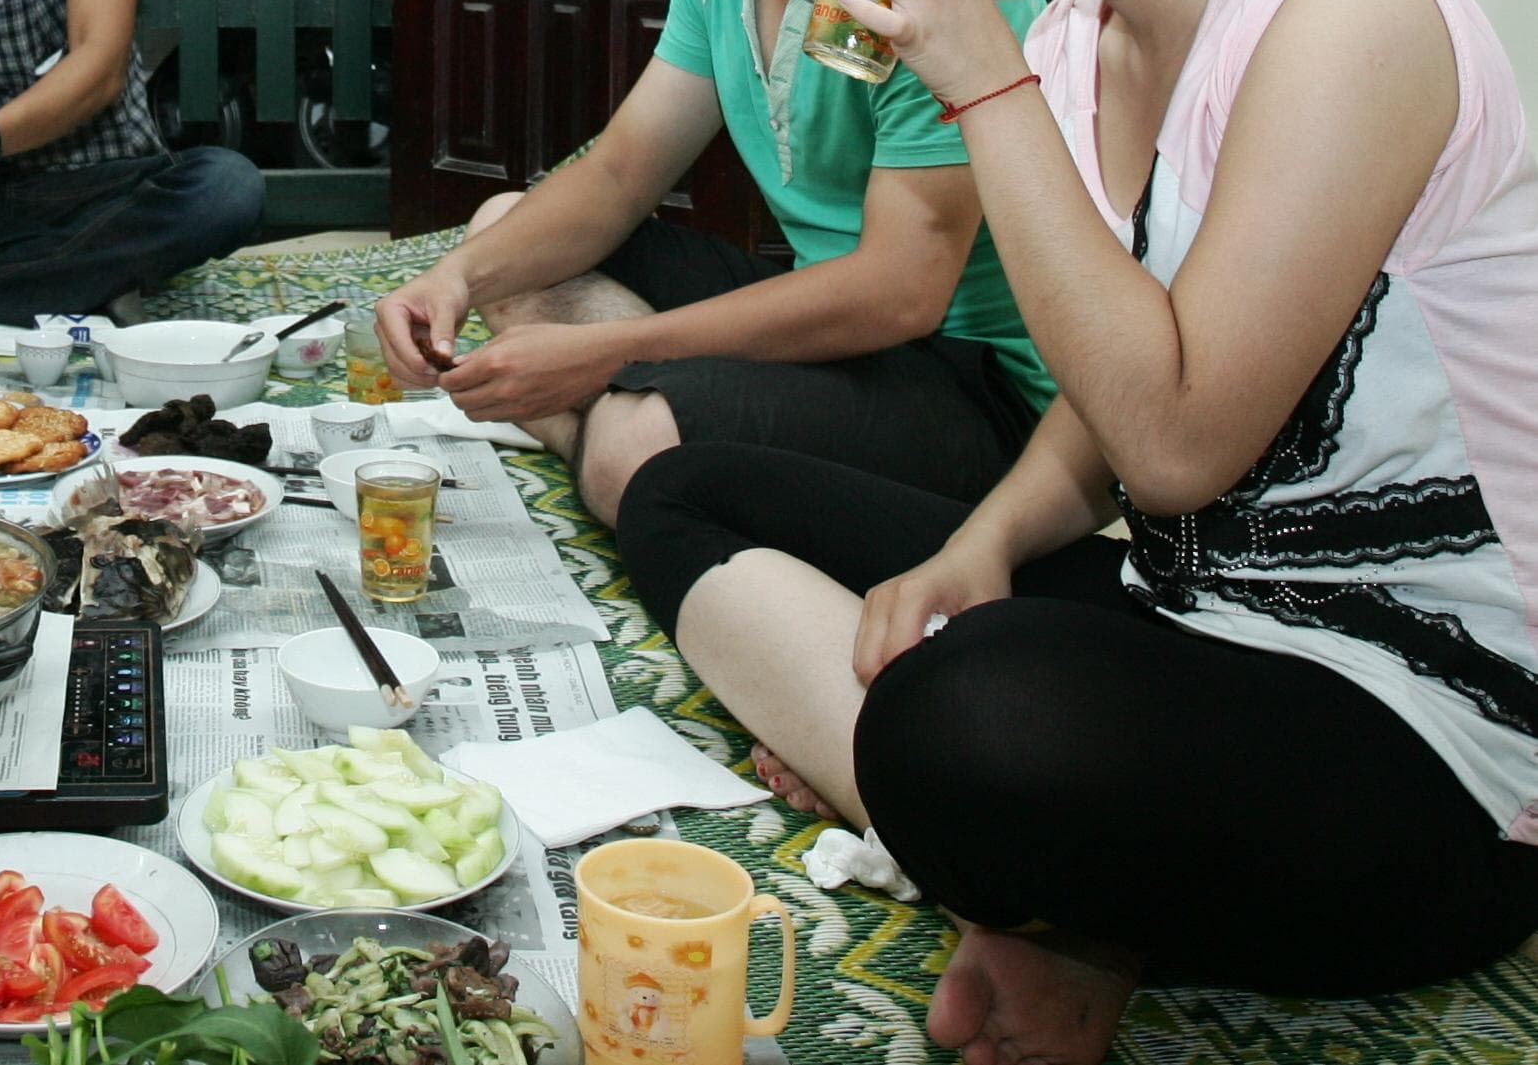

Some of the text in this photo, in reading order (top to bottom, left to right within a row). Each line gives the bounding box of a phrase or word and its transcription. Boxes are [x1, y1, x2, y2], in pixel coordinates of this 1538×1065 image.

[231, 670, 250, 687] hay
[484, 674, 515, 706] tiếng
[520, 684, 550, 713] nhân
[494, 707, 523, 742] Trung
[529, 715, 556, 737] mu
